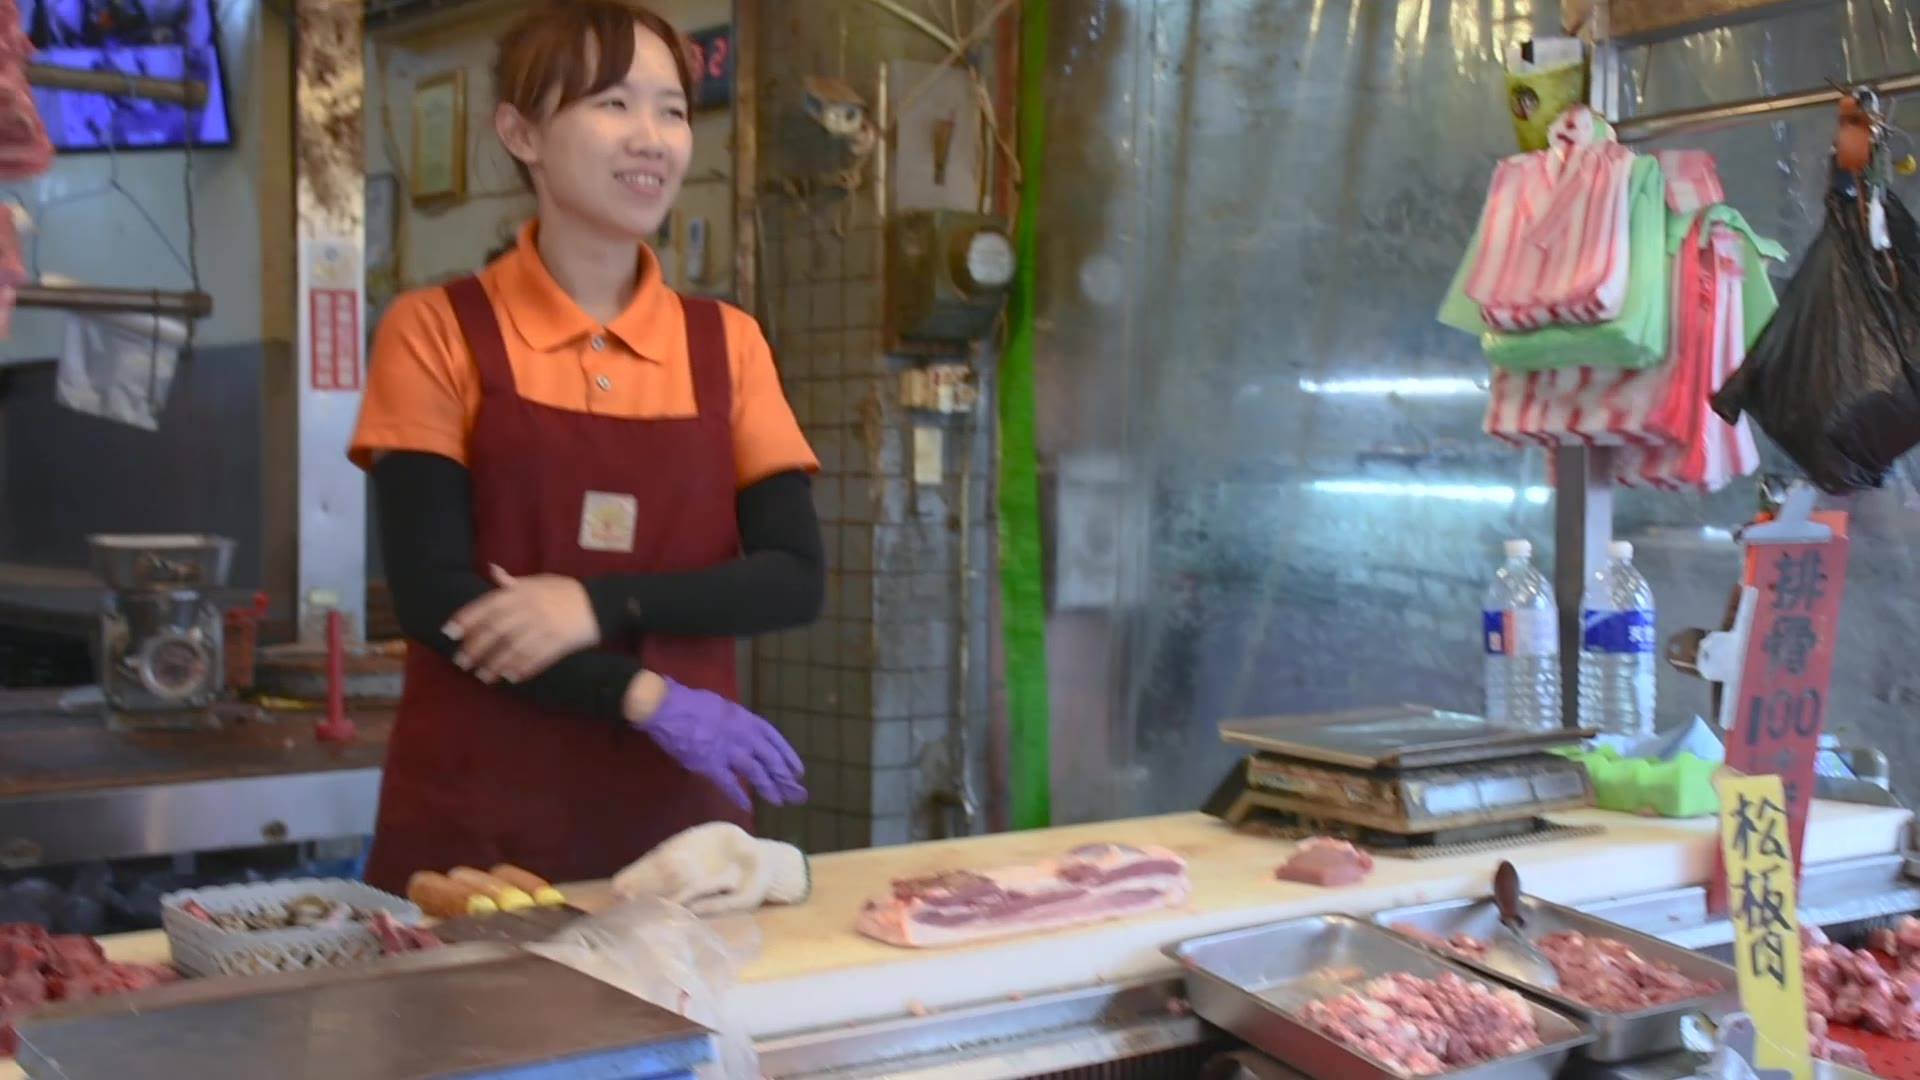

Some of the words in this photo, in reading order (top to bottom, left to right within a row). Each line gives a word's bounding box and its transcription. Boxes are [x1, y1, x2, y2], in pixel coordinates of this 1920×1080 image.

[1763, 549, 1829, 676] 排骨
[1745, 687, 1822, 745] 100
[1730, 793, 1792, 989] 松板肉
